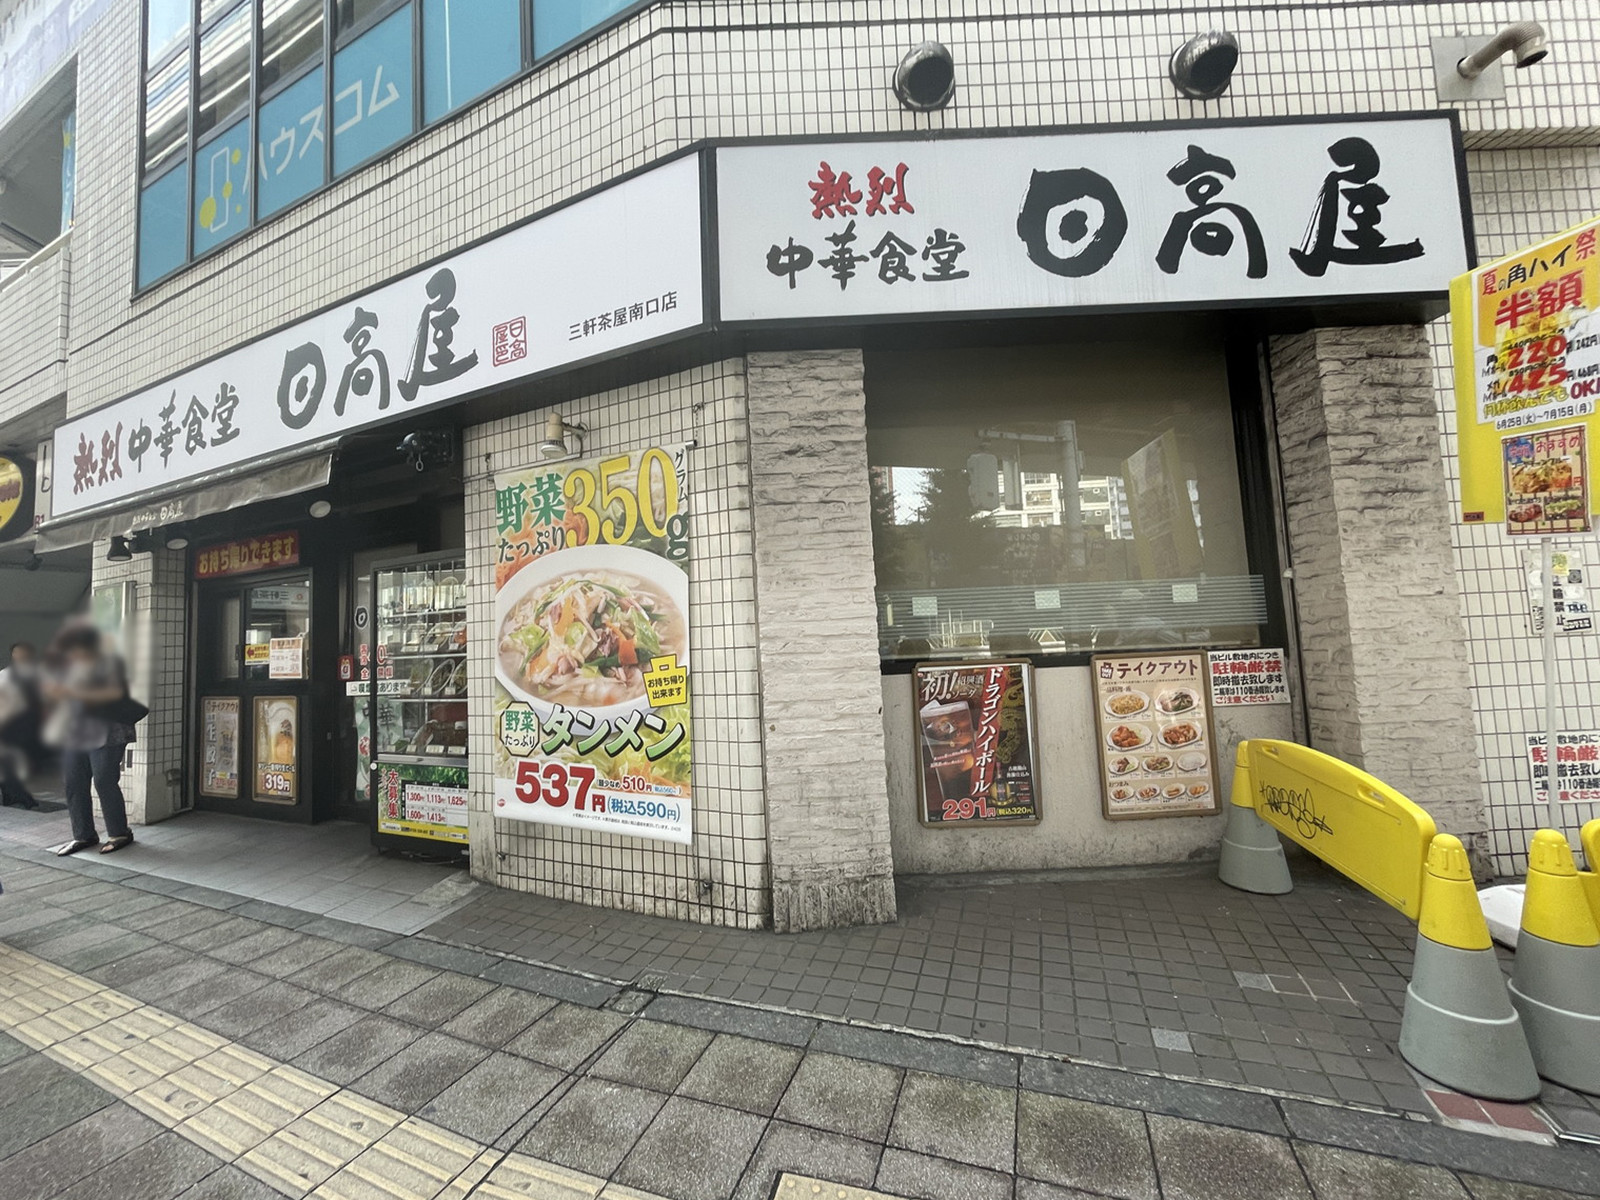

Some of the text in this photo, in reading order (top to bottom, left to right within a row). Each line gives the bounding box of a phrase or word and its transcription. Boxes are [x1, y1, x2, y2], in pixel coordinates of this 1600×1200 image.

[242, 65, 400, 194] ハウスコム
[808, 161, 915, 219] 熱烈
[1016, 136, 1425, 279] 日高屋
[767, 220, 970, 291] 中華食堂
[1482, 229, 1596, 295] 夏の角ハイ祭
[569, 291, 677, 341] 三軒茶屋南口店
[1495, 269, 1584, 329] 半額
[277, 267, 479, 430] 日高屋
[73, 421, 123, 495] 熱烈
[128, 382, 240, 473] 中華食堂
[1536, 435, 1581, 453] おすすめ
[675, 448, 689, 502] グラム
[496, 473, 565, 534] 野菜
[199, 537, 294, 573] お持ち帰りできます
[498, 525, 566, 563] たっぷり
[1117, 659, 1198, 679] テイクアウト
[1210, 652, 1280, 661] 当ビル敷地内につき
[1212, 660, 1282, 674] 駐輪厳禁
[648, 675, 684, 688] お持ち帰り
[652, 687, 682, 699] 出来ます
[952, 688, 977, 698] ソーダ
[1213, 674, 1283, 686] 即時撤去致します
[1215, 695, 1275, 704] ご注意ください
[505, 710, 535, 733] 野菜
[541, 703, 685, 762] タンメン
[971, 666, 1003, 796] ドラゴンハイボール
[266, 773, 290, 791] 319円
[388, 769, 398, 818] 大募集
[515, 761, 605, 812] 537円
[622, 776, 652, 791] 510円
[607, 796, 680, 823] (税込590円)
[942, 797, 996, 820] 291円
